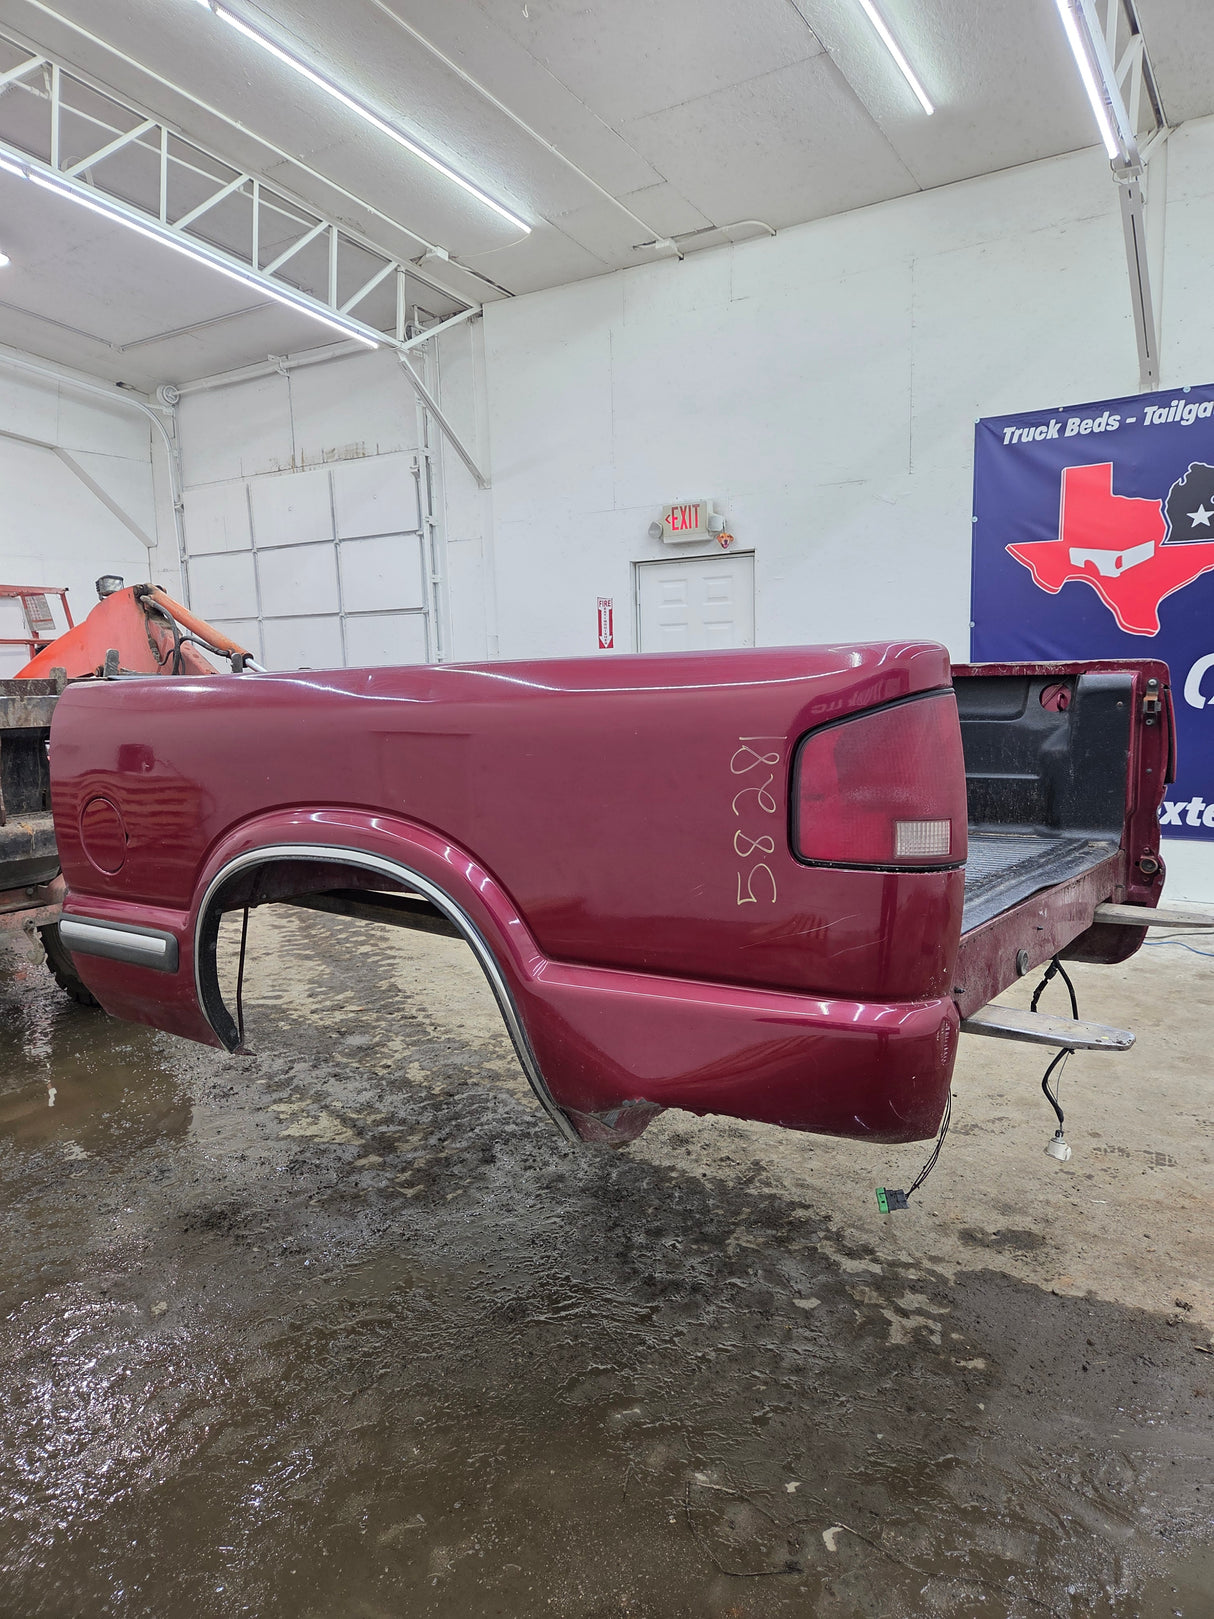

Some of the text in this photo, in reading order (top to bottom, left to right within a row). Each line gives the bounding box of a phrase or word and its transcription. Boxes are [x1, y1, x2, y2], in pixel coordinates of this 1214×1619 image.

[1003, 419, 1062, 445] Truck
[1064, 411, 1121, 437] Beds
[1143, 399, 1214, 426] Tailga
[671, 504, 700, 531] EXIT
[599, 600, 611, 608] FIRE
[730, 735, 788, 905] 58281
[1158, 796, 1214, 828] xte
